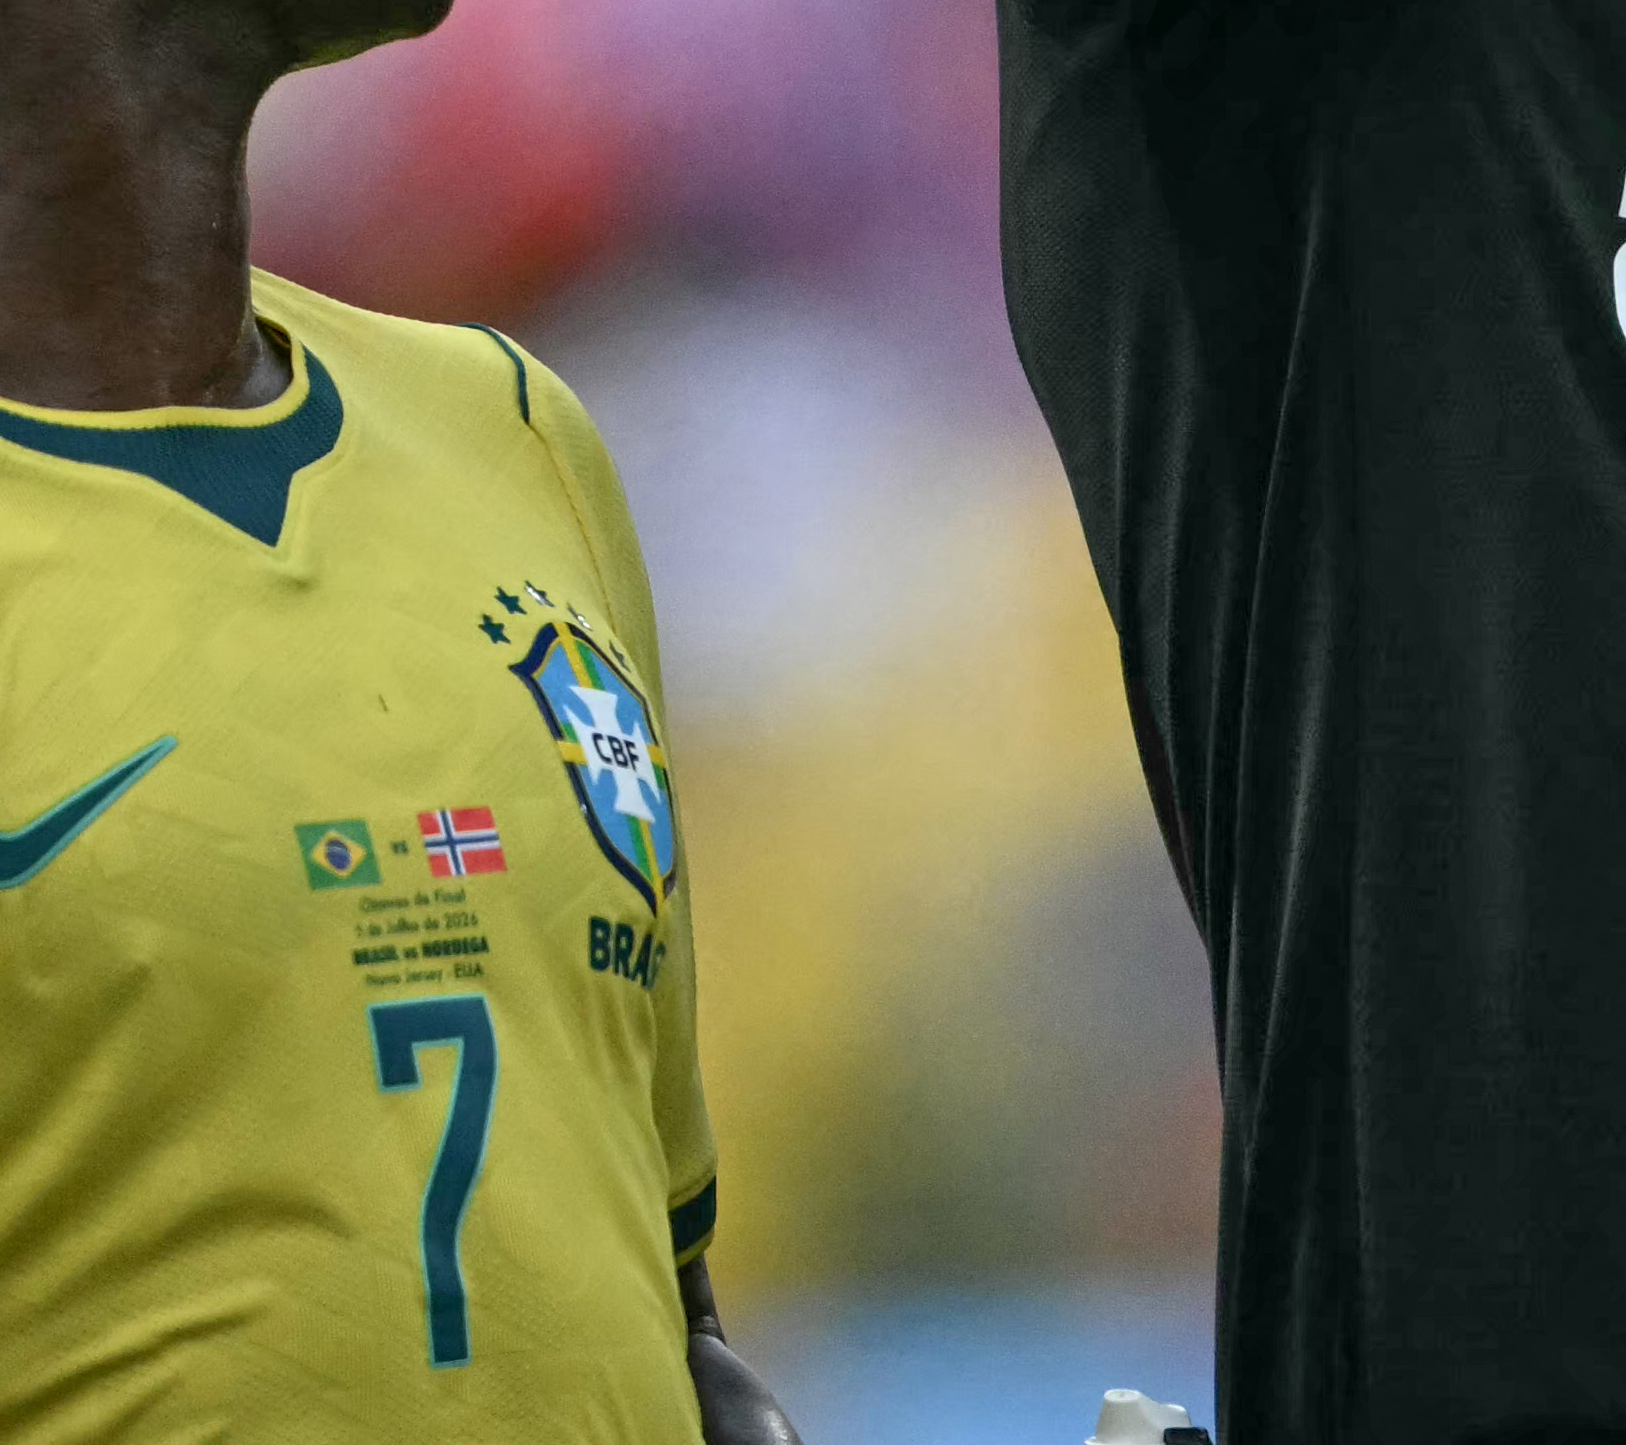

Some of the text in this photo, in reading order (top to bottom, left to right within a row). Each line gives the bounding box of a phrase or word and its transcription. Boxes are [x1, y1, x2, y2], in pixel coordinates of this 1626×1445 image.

[591, 732, 639, 773] CBF
[444, 911, 478, 929] 2026
[366, 993, 498, 1369] 7
